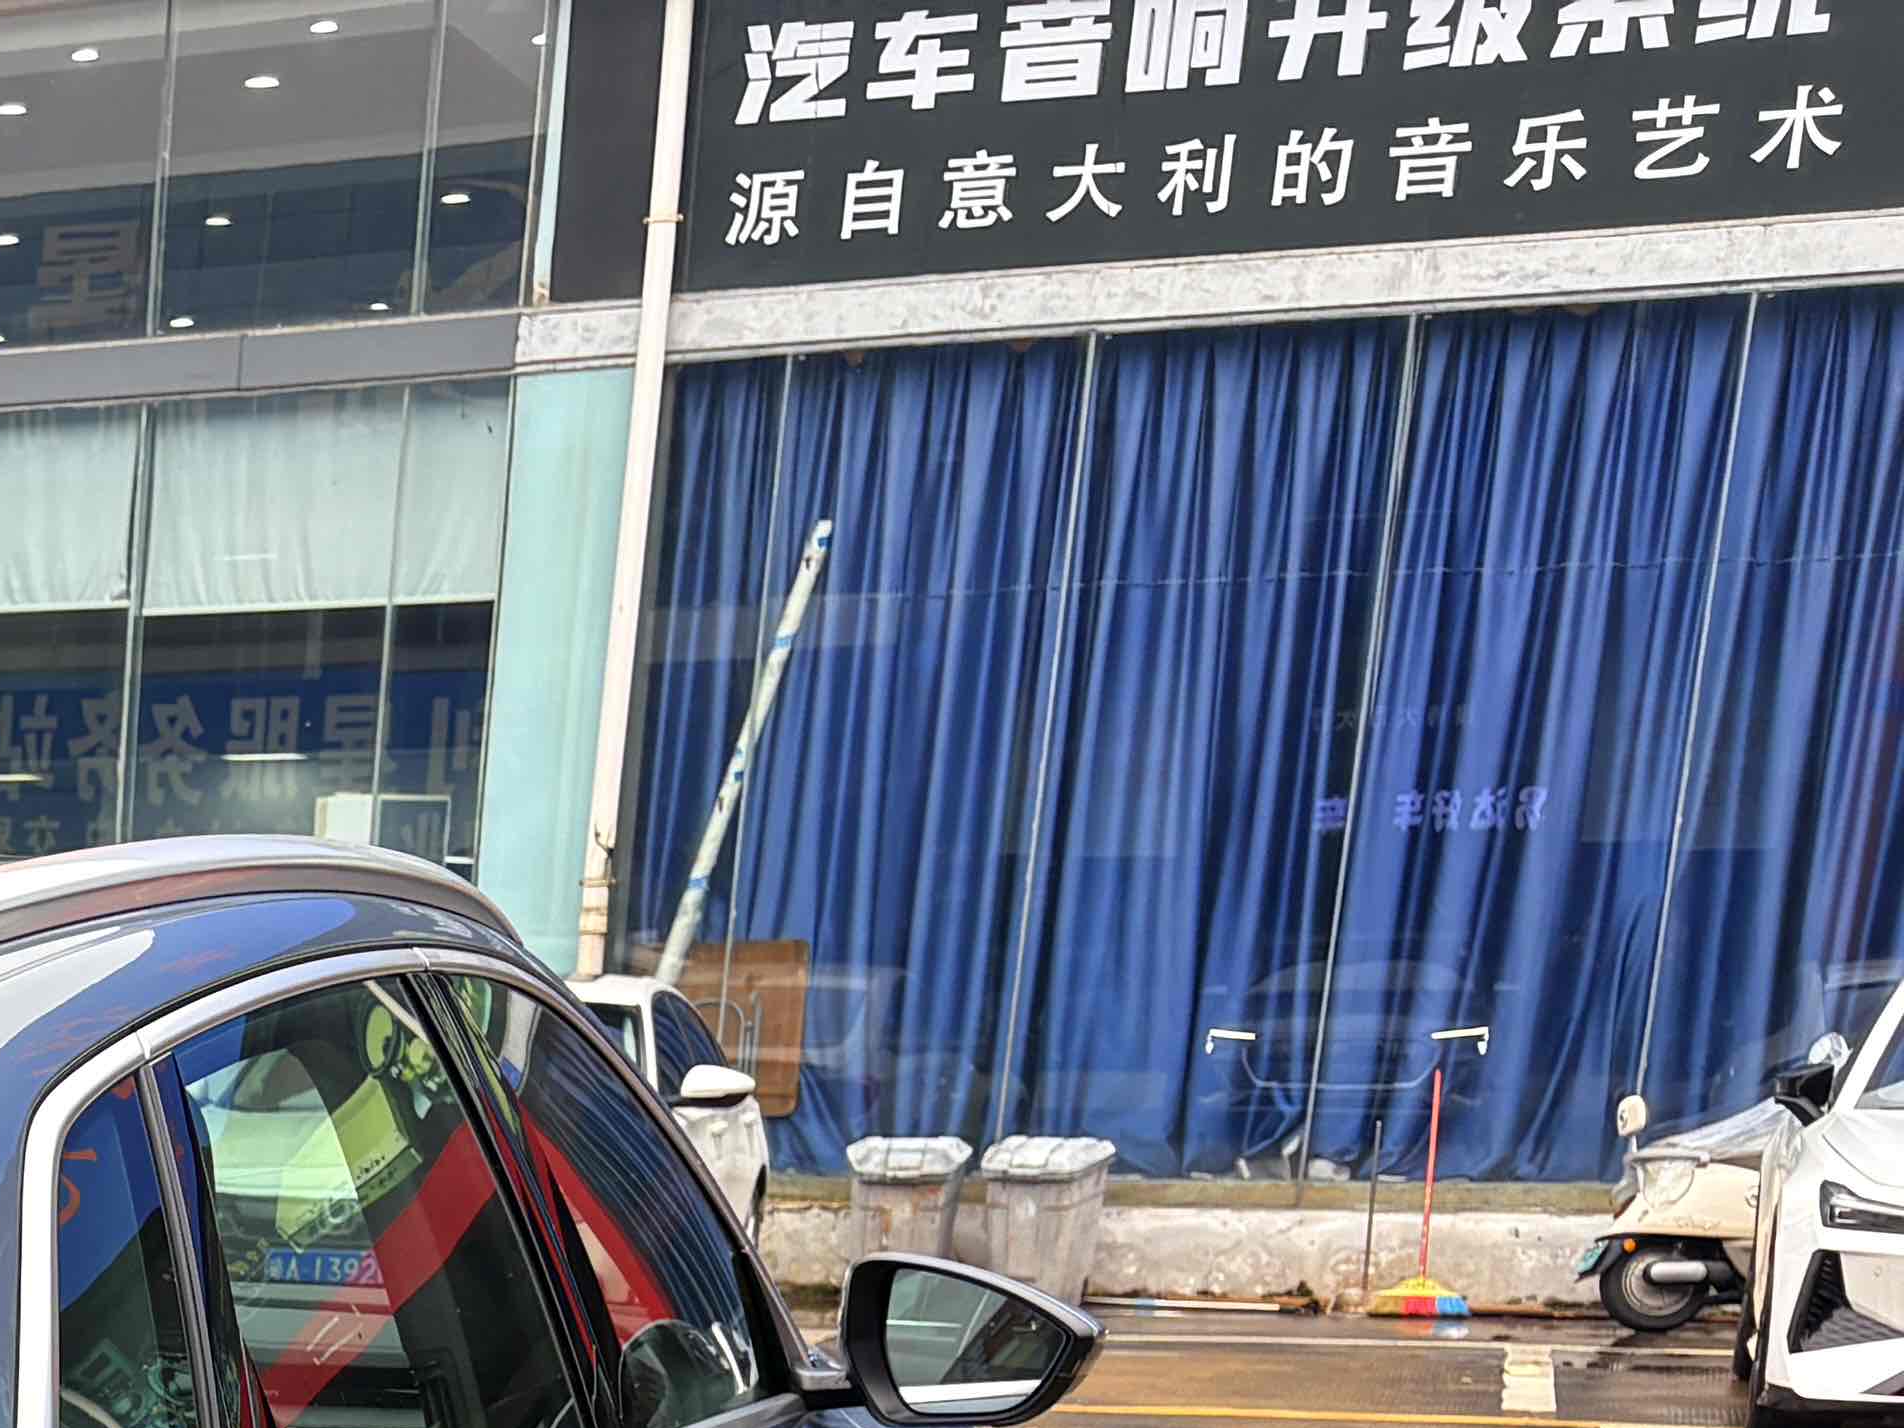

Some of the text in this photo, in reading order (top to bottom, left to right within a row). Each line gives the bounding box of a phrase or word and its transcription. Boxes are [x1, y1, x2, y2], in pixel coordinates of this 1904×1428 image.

[725, 84, 1845, 246] 源自意大利的音乐艺术
